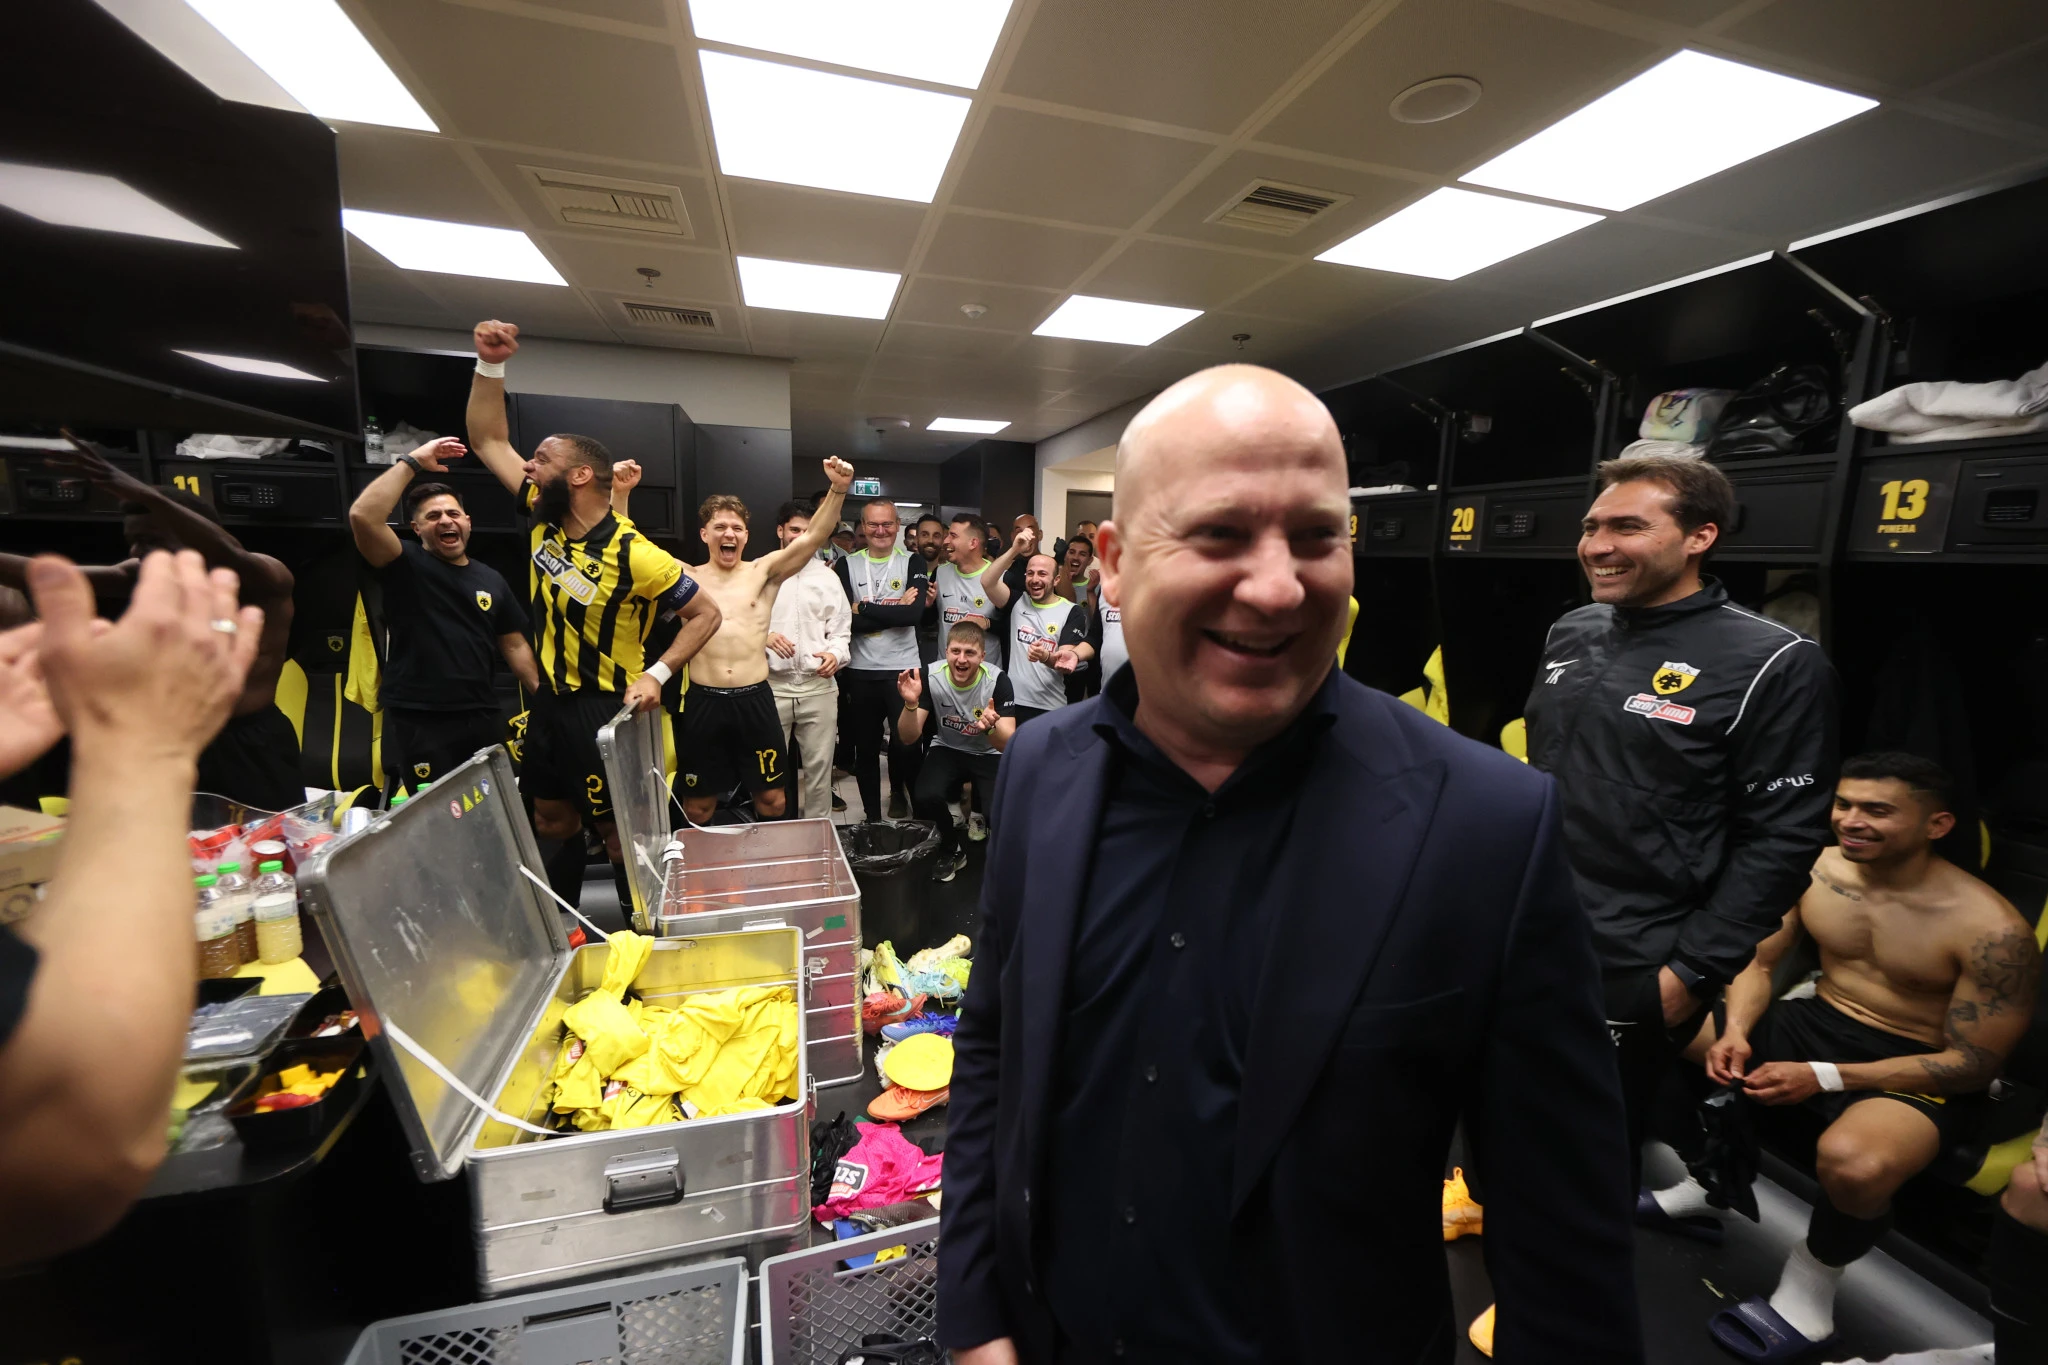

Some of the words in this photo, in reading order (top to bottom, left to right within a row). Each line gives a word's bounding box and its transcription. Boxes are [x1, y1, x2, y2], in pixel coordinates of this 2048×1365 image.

[172, 475, 200, 496] 11
[1880, 479, 1930, 520] 13
[1350, 514, 1358, 535] 3
[1450, 507, 1475, 532] 20
[755, 748, 777, 774] 17
[586, 774, 604, 804] 2
